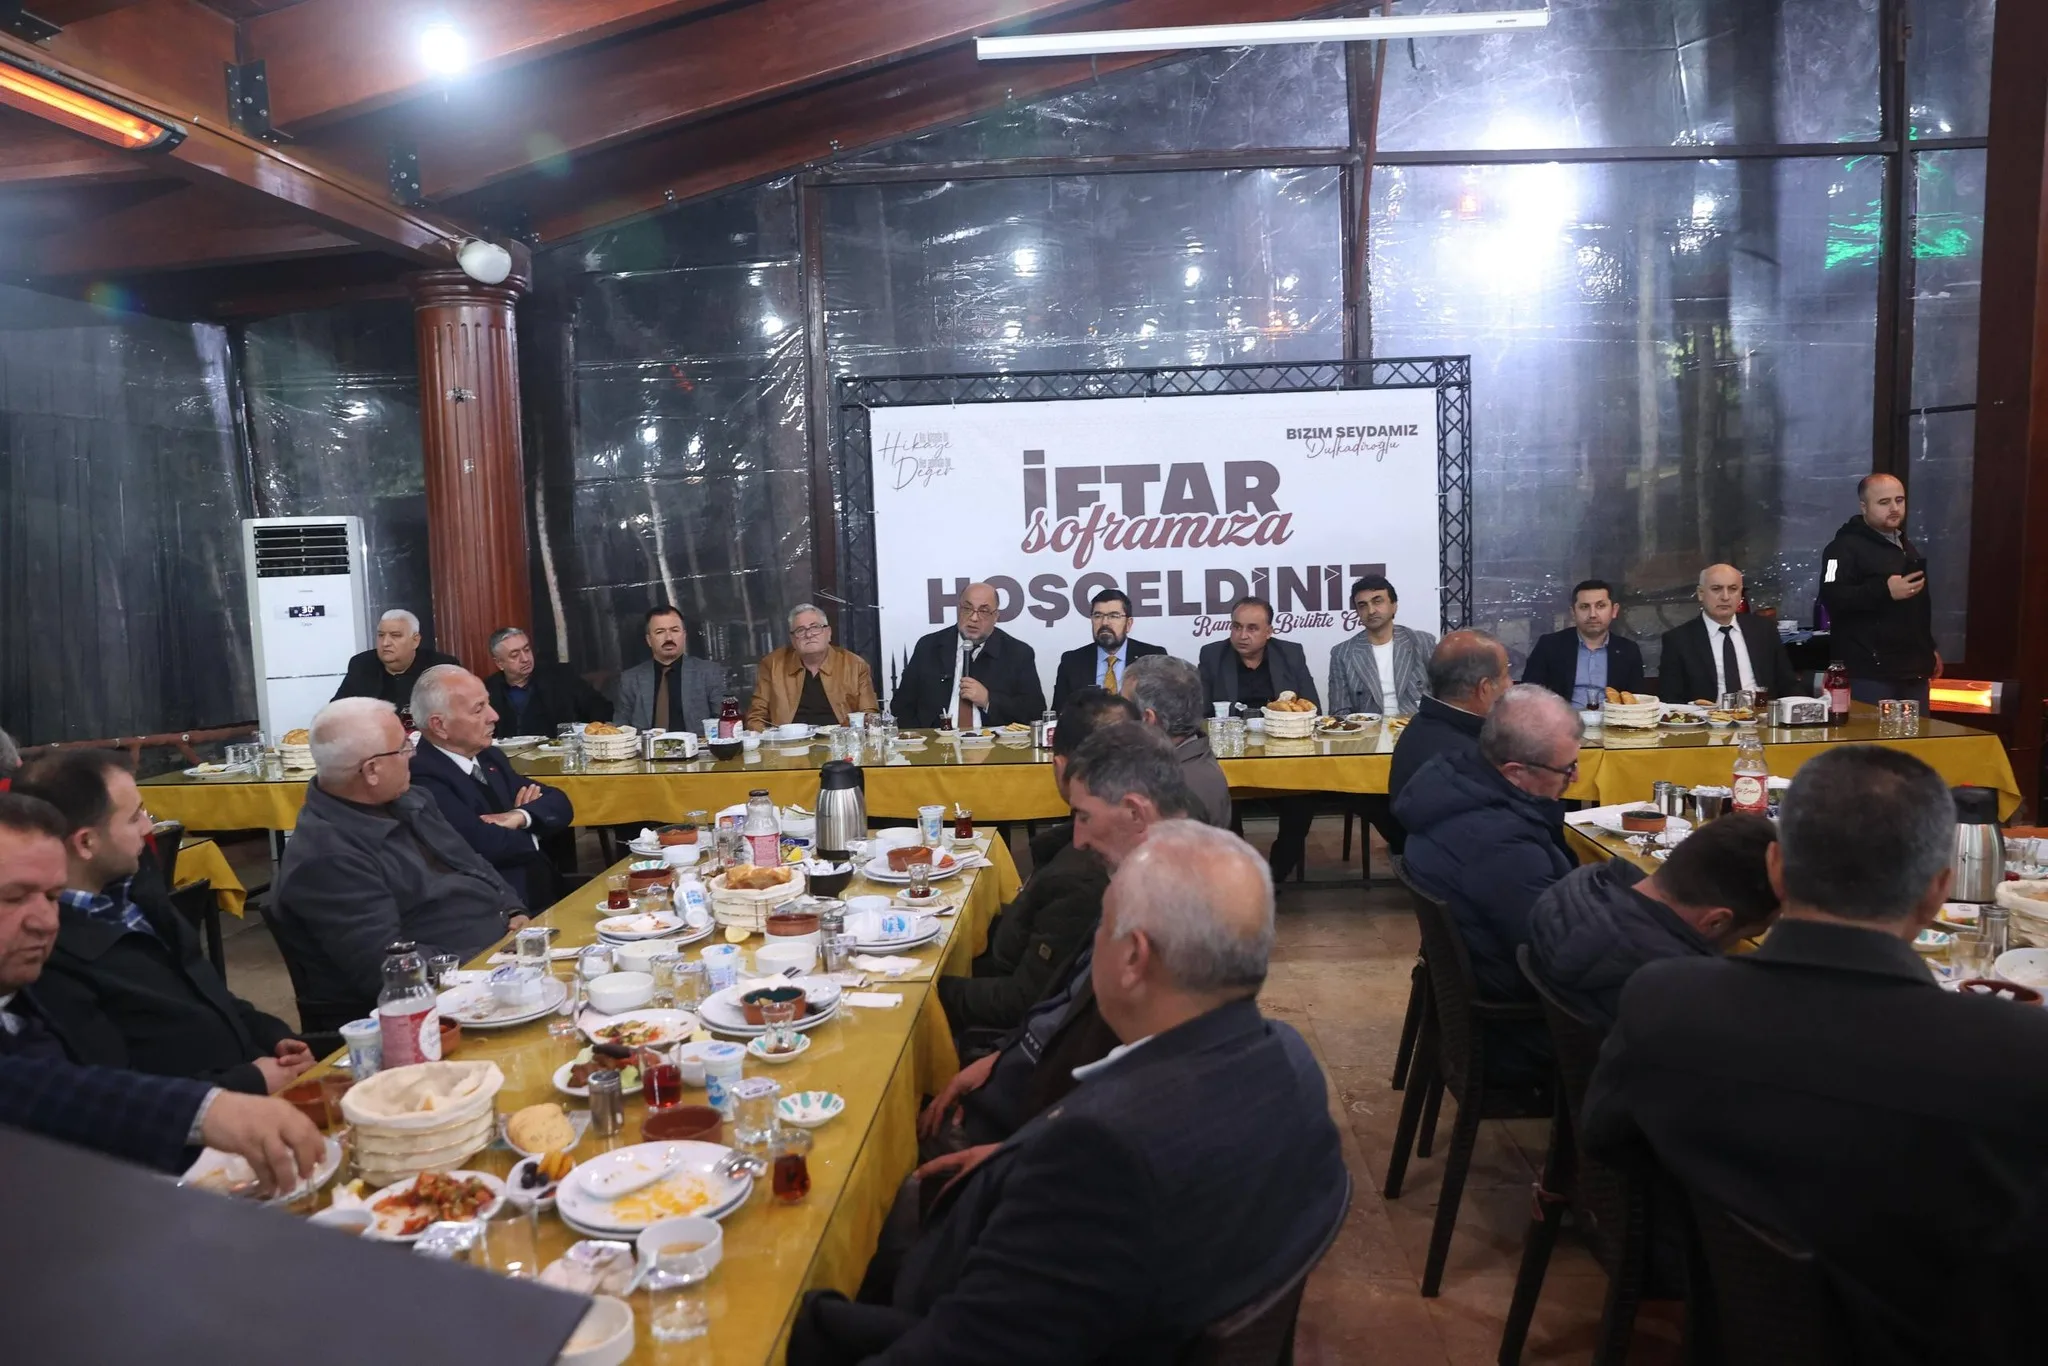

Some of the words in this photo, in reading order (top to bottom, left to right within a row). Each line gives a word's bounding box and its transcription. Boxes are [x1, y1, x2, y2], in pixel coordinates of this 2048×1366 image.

[1336, 424, 1419, 438] SEVDAMIZ
[1023, 449, 1281, 530] İFTAR
[1021, 503, 1295, 569] soframıza
[1272, 612, 1334, 634] Birlikte
